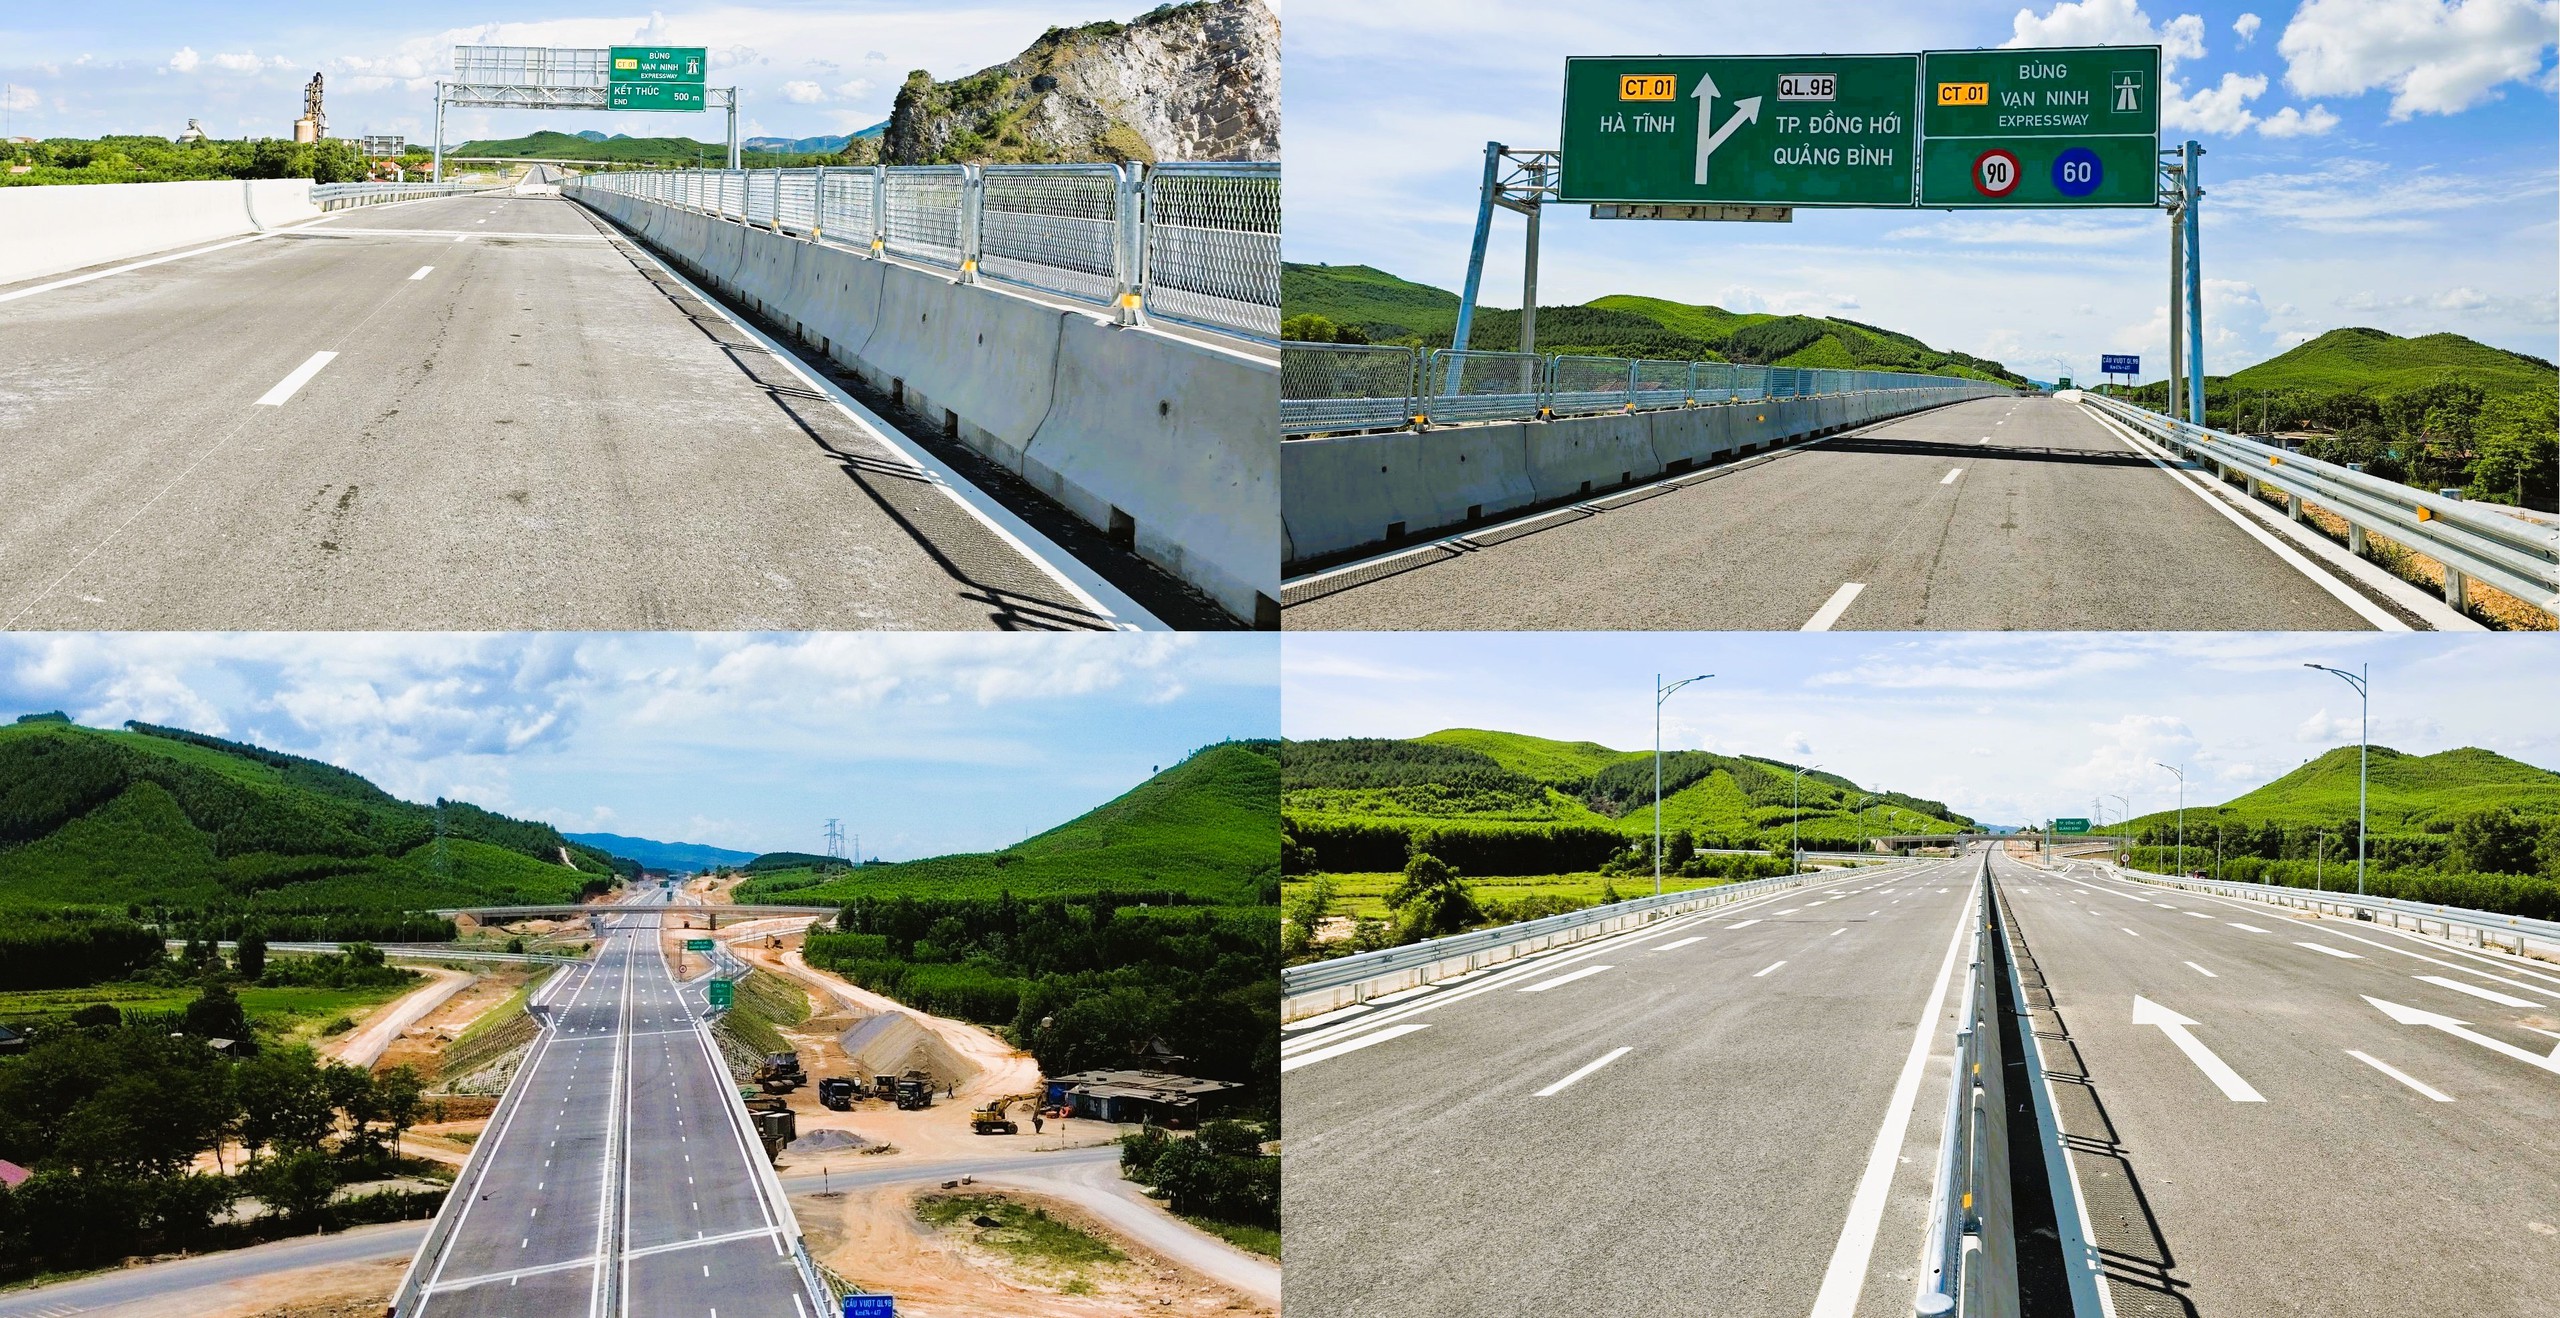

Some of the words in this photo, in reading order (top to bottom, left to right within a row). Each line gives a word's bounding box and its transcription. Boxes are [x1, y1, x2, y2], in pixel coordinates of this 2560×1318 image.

[649, 51, 671, 60] BÙNG
[659, 63, 679, 71] NINH
[2019, 60, 2068, 80] BÙNG
[614, 84, 632, 95] KẾT
[635, 85, 660, 96] THÚC
[1625, 79, 1671, 96] CT.01
[1780, 79, 1834, 96] QL.9B
[674, 93, 690, 101] 500
[2000, 91, 2035, 109] VẠN
[2046, 90, 2089, 106] NINH
[1600, 112, 1626, 133] HÀ
[1633, 112, 1675, 133] TĨNH
[1776, 116, 1802, 134] TP.
[1808, 109, 1863, 134] ĐỒNG
[1869, 111, 1901, 134] HỚI
[1999, 114, 2089, 127] EXPRESSWAY
[1773, 142, 1840, 165] QUẢNG
[1847, 143, 1893, 166] BÌNH
[1987, 162, 2007, 184] 90
[2063, 161, 2092, 183] 60
